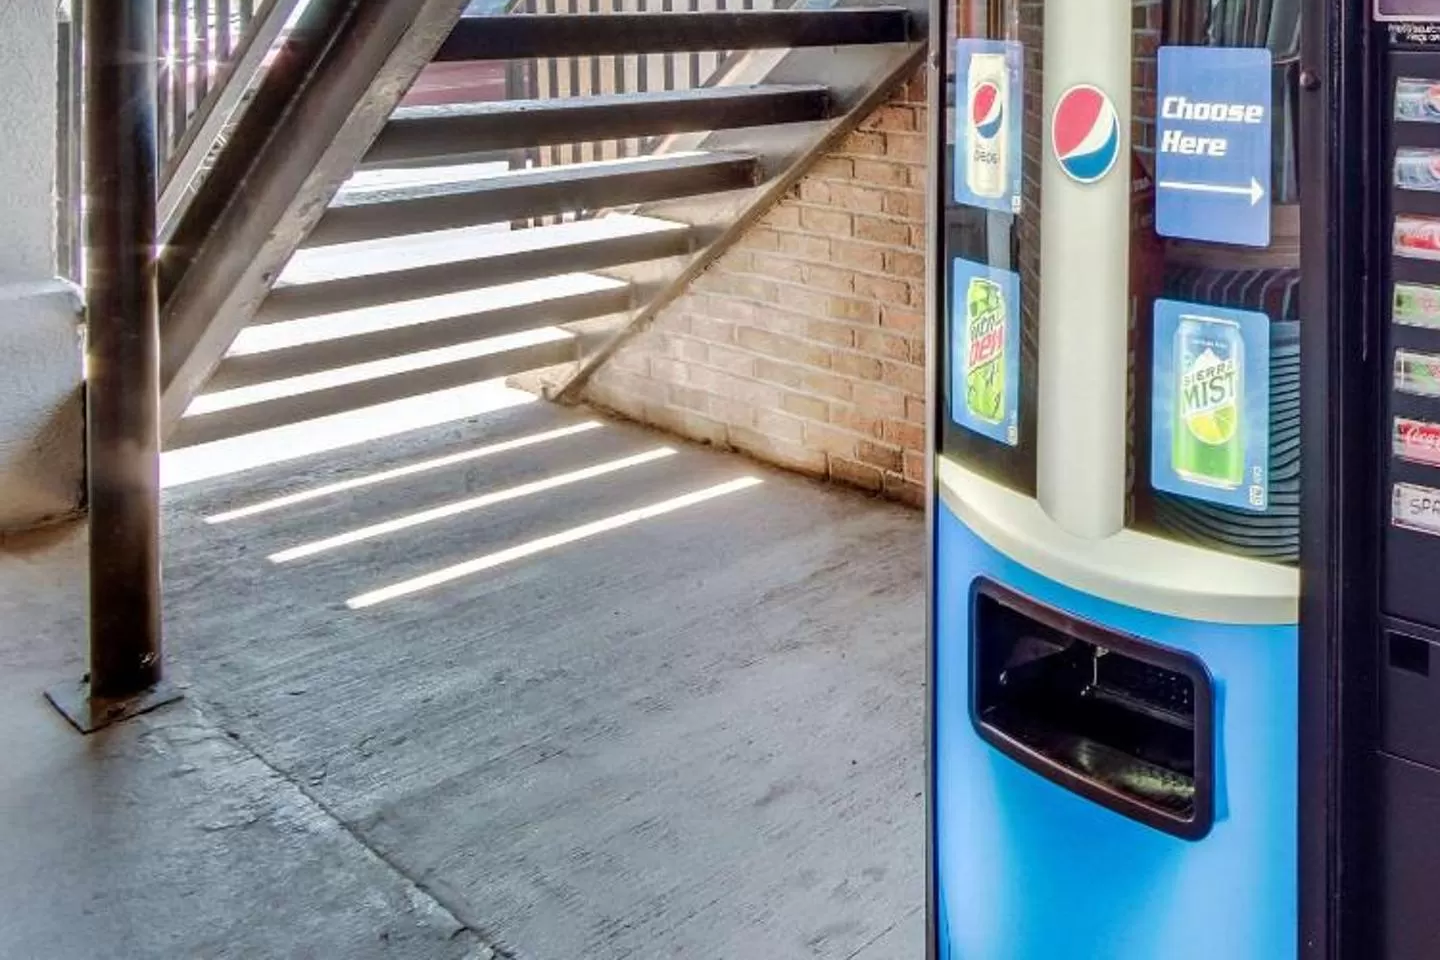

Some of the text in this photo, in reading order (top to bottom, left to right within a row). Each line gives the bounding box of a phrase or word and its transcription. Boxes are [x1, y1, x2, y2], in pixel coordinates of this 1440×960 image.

[1162, 96, 1265, 124] Choose
[1161, 130, 1228, 157] Here
[1184, 360, 1233, 387] SIERRA
[1183, 372, 1235, 414] MIST
